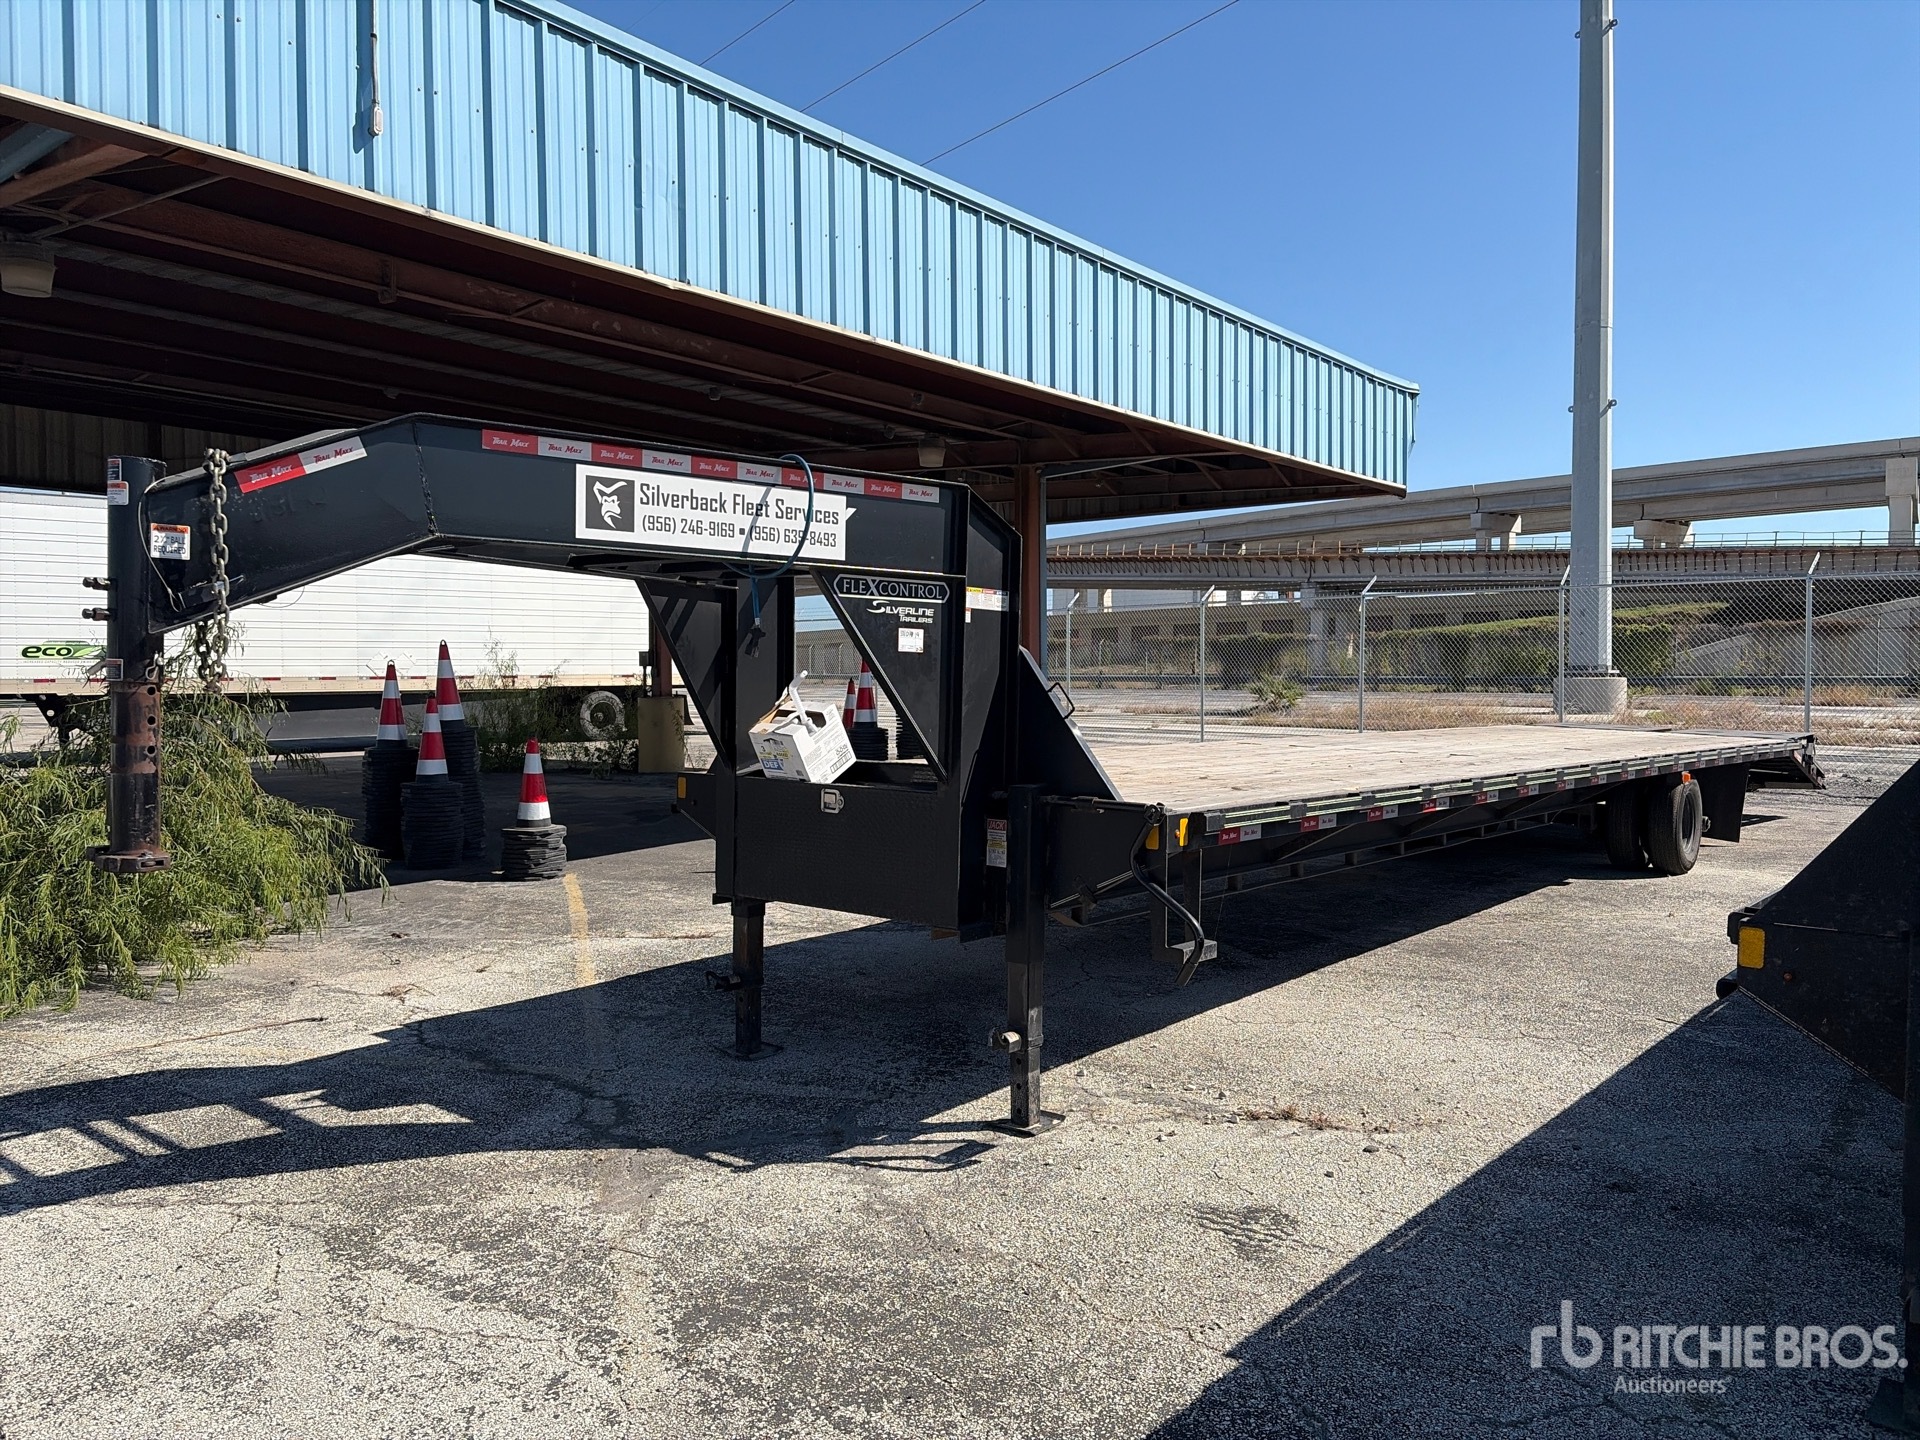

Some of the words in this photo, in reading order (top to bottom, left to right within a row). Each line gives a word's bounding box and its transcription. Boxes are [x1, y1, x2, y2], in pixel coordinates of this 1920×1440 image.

[640, 483, 727, 513] Silverback
[733, 493, 770, 517] Fleet
[642, 514, 677, 535] (956)
[680, 518, 735, 538] 246-9169
[750, 525, 780, 544] (956)
[171, 536, 185, 544] BALL
[153, 545, 186, 555] REQUIRED
[843, 577, 942, 599] FLEXCONTROL
[21, 646, 72, 658] eco
[763, 760, 779, 769] DEF
[988, 820, 1005, 830] JACK
